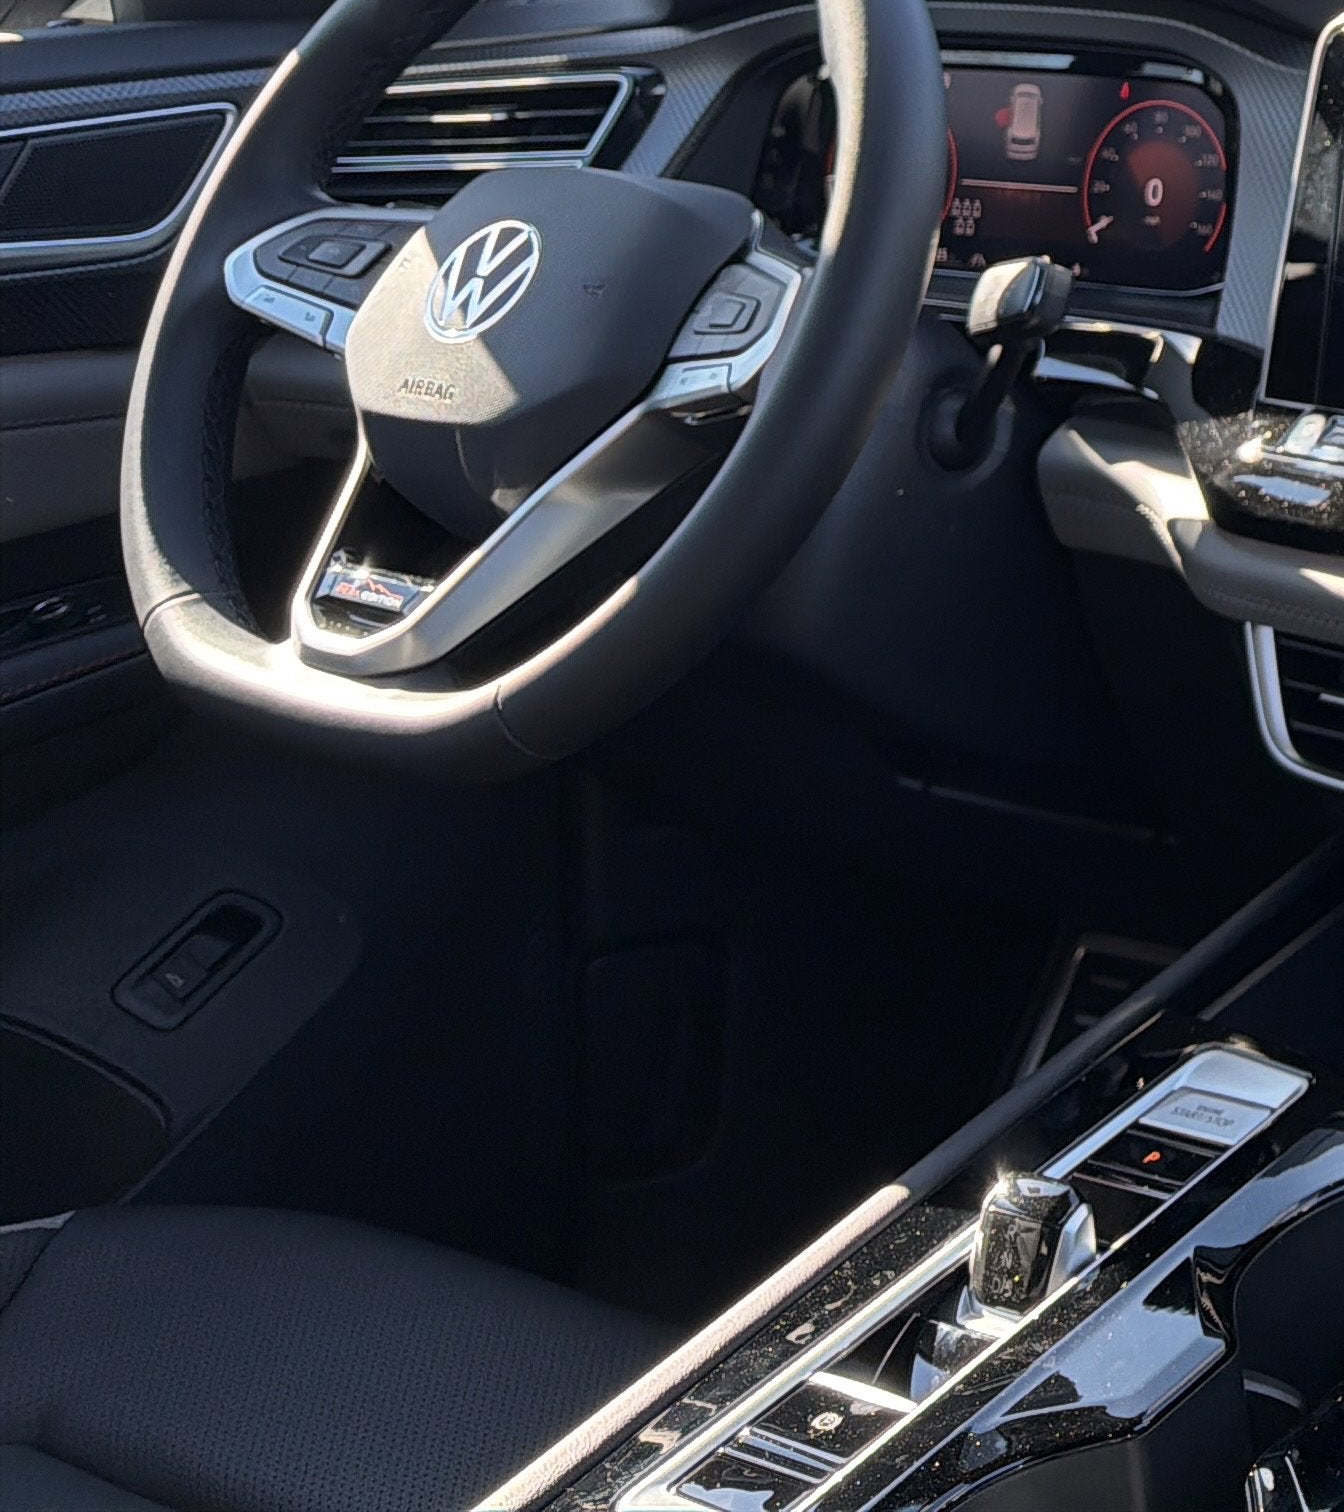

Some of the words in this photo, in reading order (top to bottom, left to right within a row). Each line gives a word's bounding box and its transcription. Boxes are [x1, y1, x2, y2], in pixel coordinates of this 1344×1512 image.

[1143, 177, 1165, 208] 0
[424, 218, 541, 345] VW
[400, 377, 457, 401] AIRBAG
[1141, 1150, 1162, 1165] P
